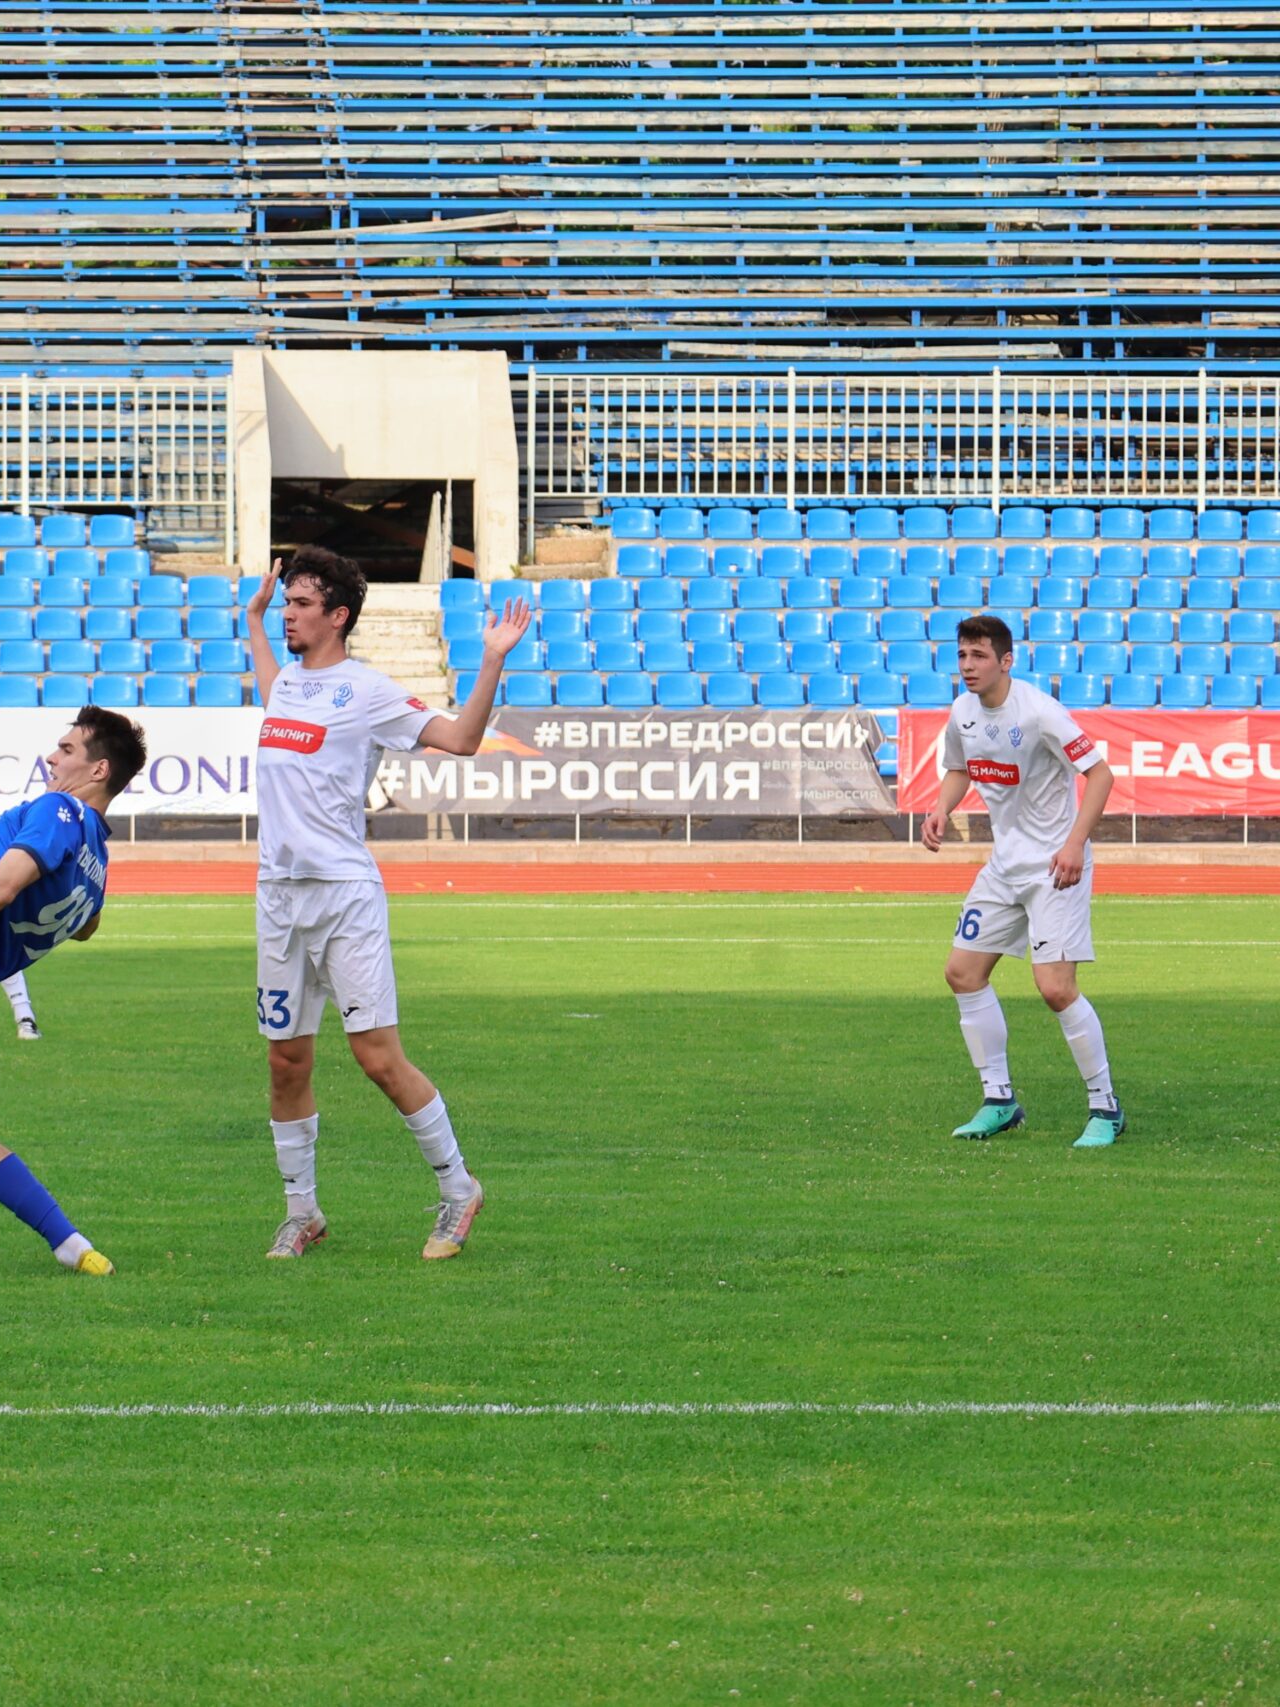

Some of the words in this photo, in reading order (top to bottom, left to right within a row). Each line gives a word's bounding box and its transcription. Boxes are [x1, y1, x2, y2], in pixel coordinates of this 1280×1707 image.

[271, 727, 315, 744] МАГНИТ
[376, 760, 760, 800] #МЫРОССИЯ
[980, 768, 1015, 779] МАГНИТ
